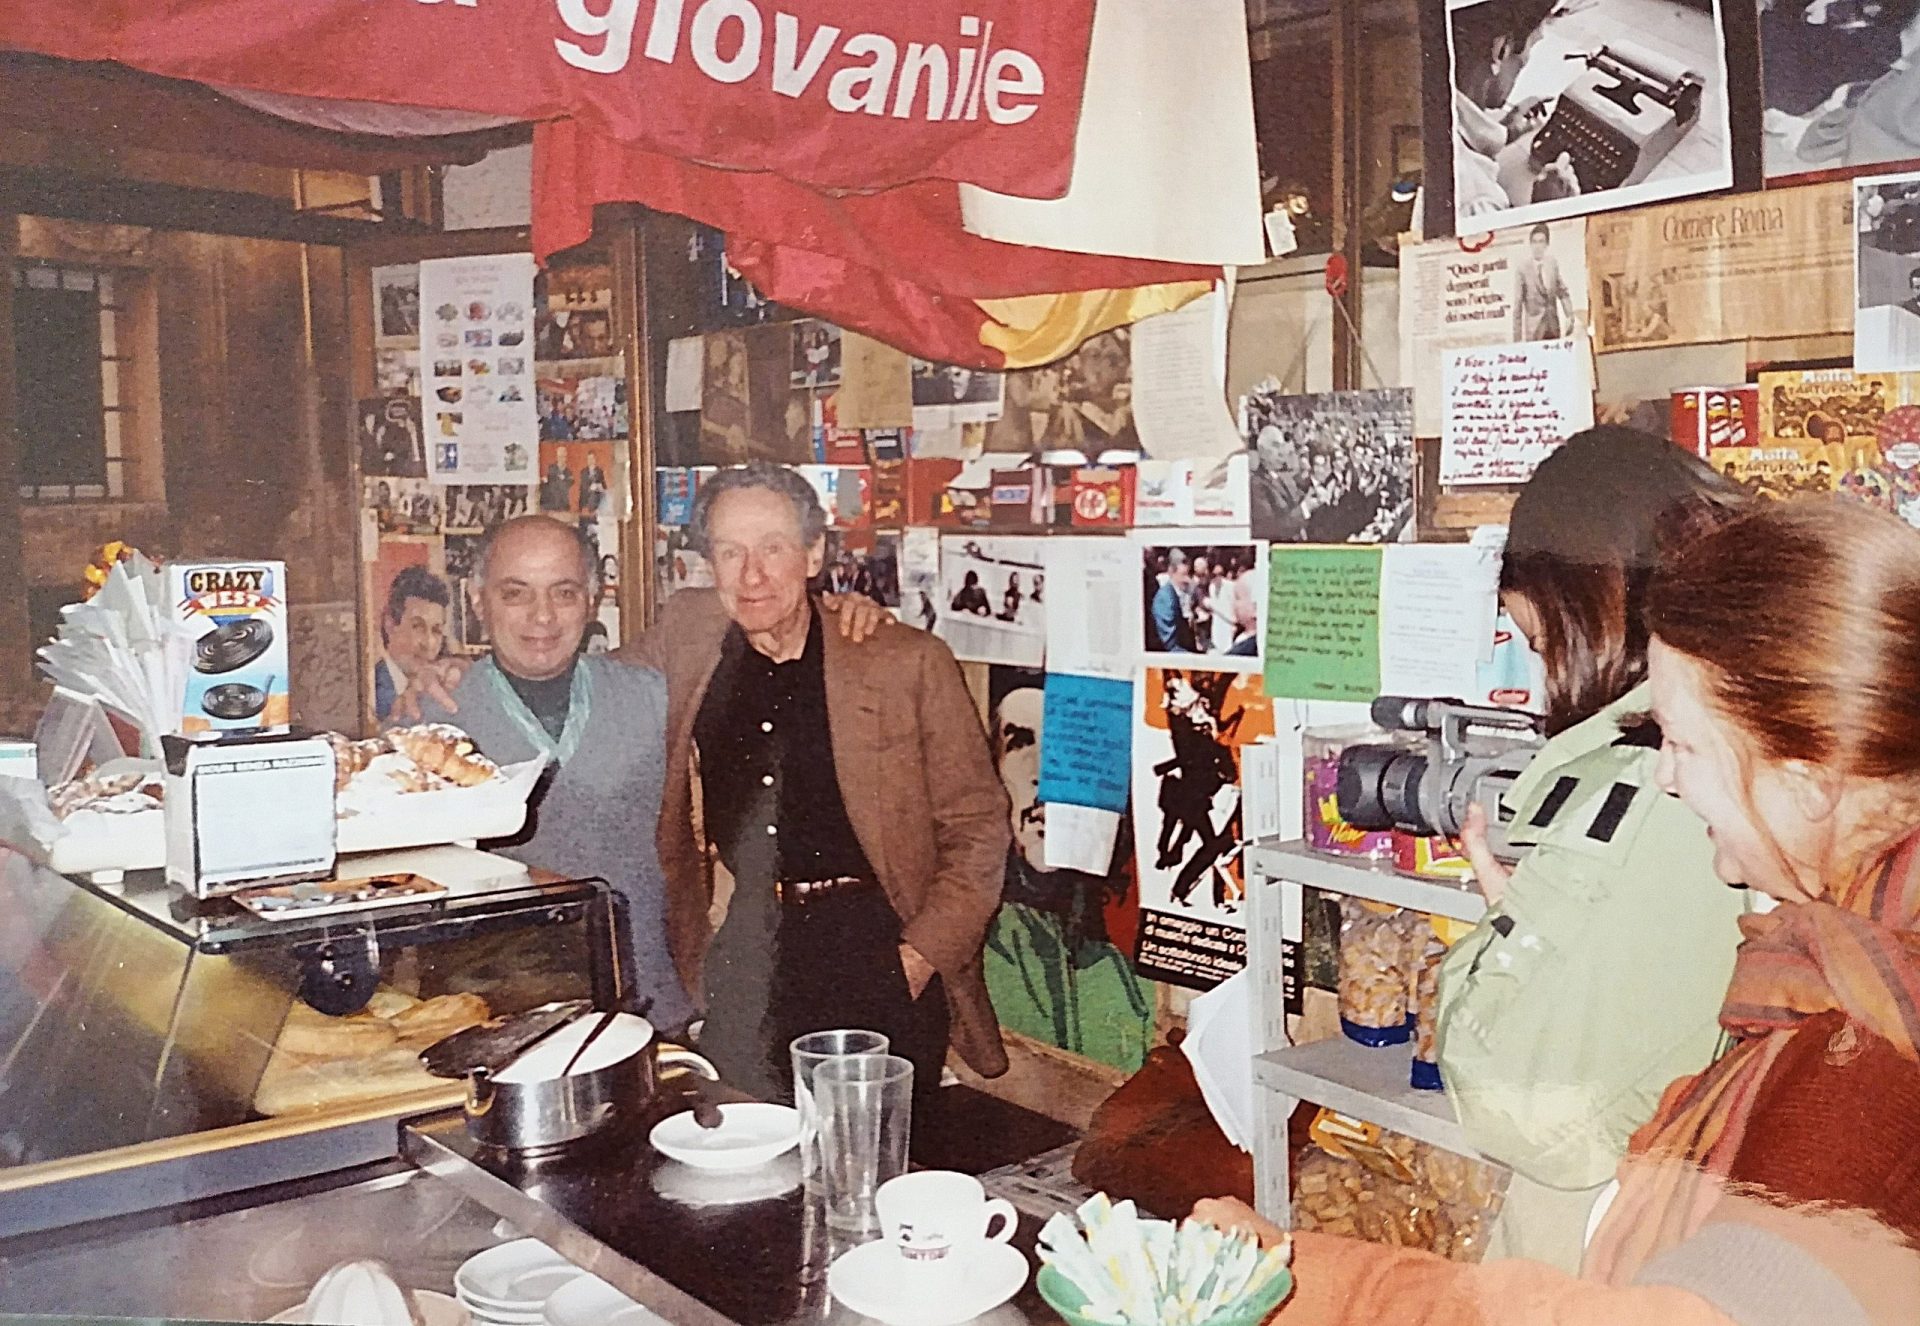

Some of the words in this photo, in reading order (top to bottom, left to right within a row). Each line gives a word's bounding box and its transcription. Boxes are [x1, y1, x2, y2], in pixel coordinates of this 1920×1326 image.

[1662, 209, 1727, 242] Corriere
[1730, 205, 1784, 236] Roma
[1787, 382, 1869, 395] TARTUFONE
[1737, 462, 1813, 474] TARTUFONE
[190, 570, 264, 593] CRAZY
[197, 590, 261, 610] WEST
[1146, 912, 1157, 923] In
[1159, 915, 1203, 934] omaggio
[1205, 926, 1220, 937] un
[1141, 939, 1158, 952] Un
[1158, 945, 1212, 965] sottofondo
[1213, 955, 1243, 971] ideale
